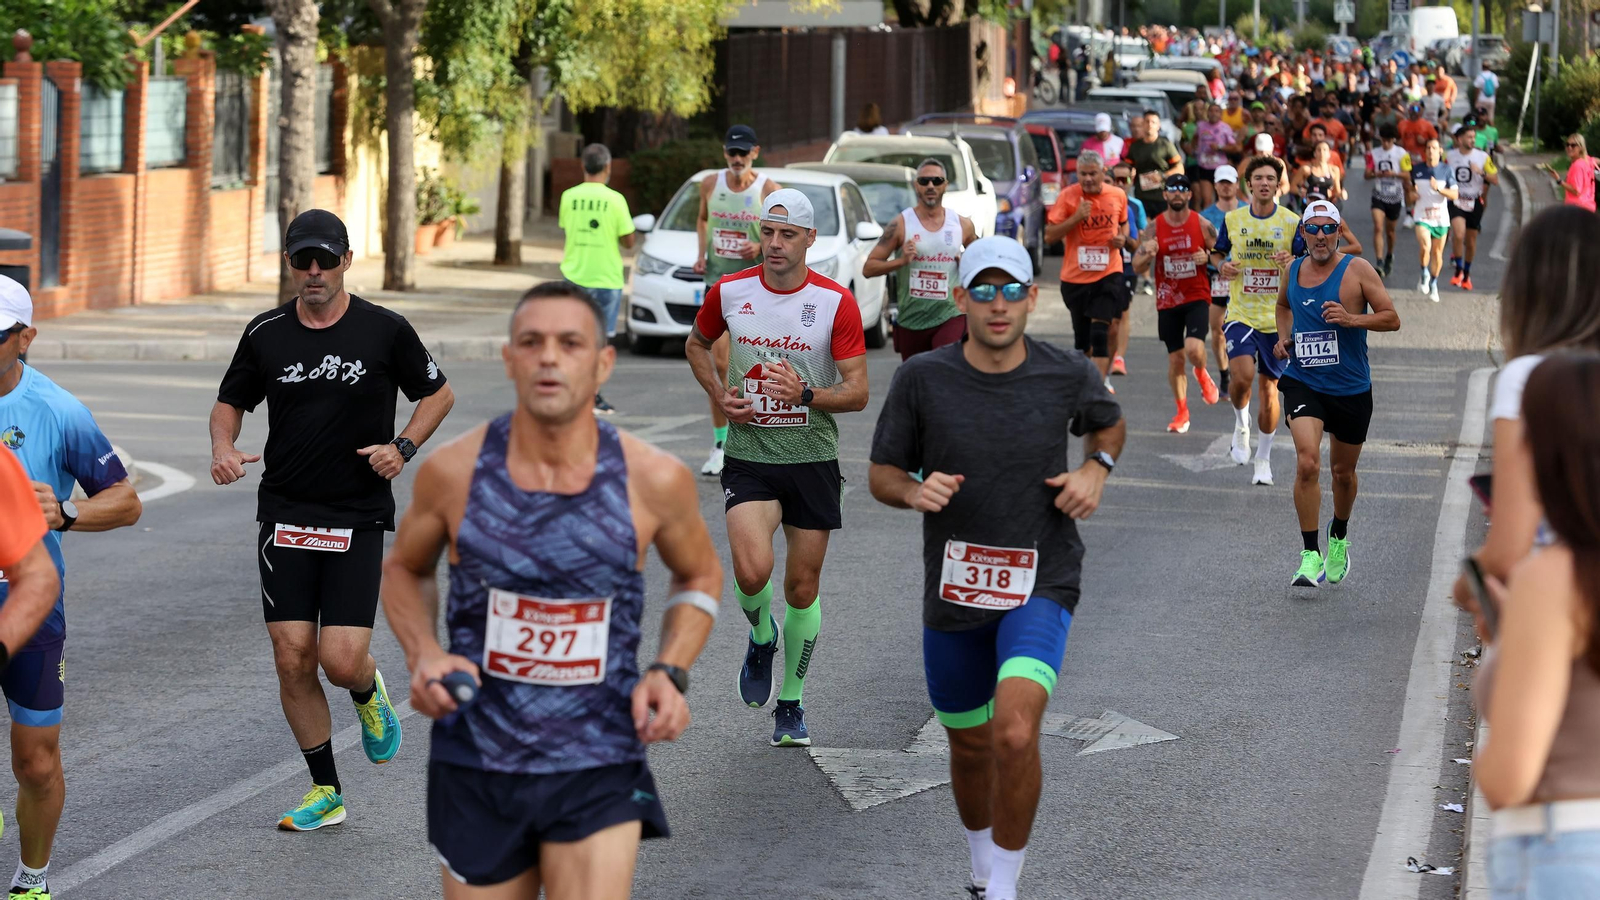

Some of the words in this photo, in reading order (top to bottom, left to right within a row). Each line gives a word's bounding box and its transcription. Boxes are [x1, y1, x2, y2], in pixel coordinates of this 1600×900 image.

[572, 199, 608, 211] STAFF
[720, 239, 739, 249] 173
[1237, 252, 1263, 261] OLIMPO
[920, 279, 939, 290] 150
[1252, 277, 1271, 286] 237
[737, 334, 812, 352] maratón
[1300, 342, 1331, 356] 1114
[756, 350, 790, 359] JEREZ
[760, 396, 793, 413] 134
[965, 565, 1011, 590] 318
[516, 626, 577, 656] 297
